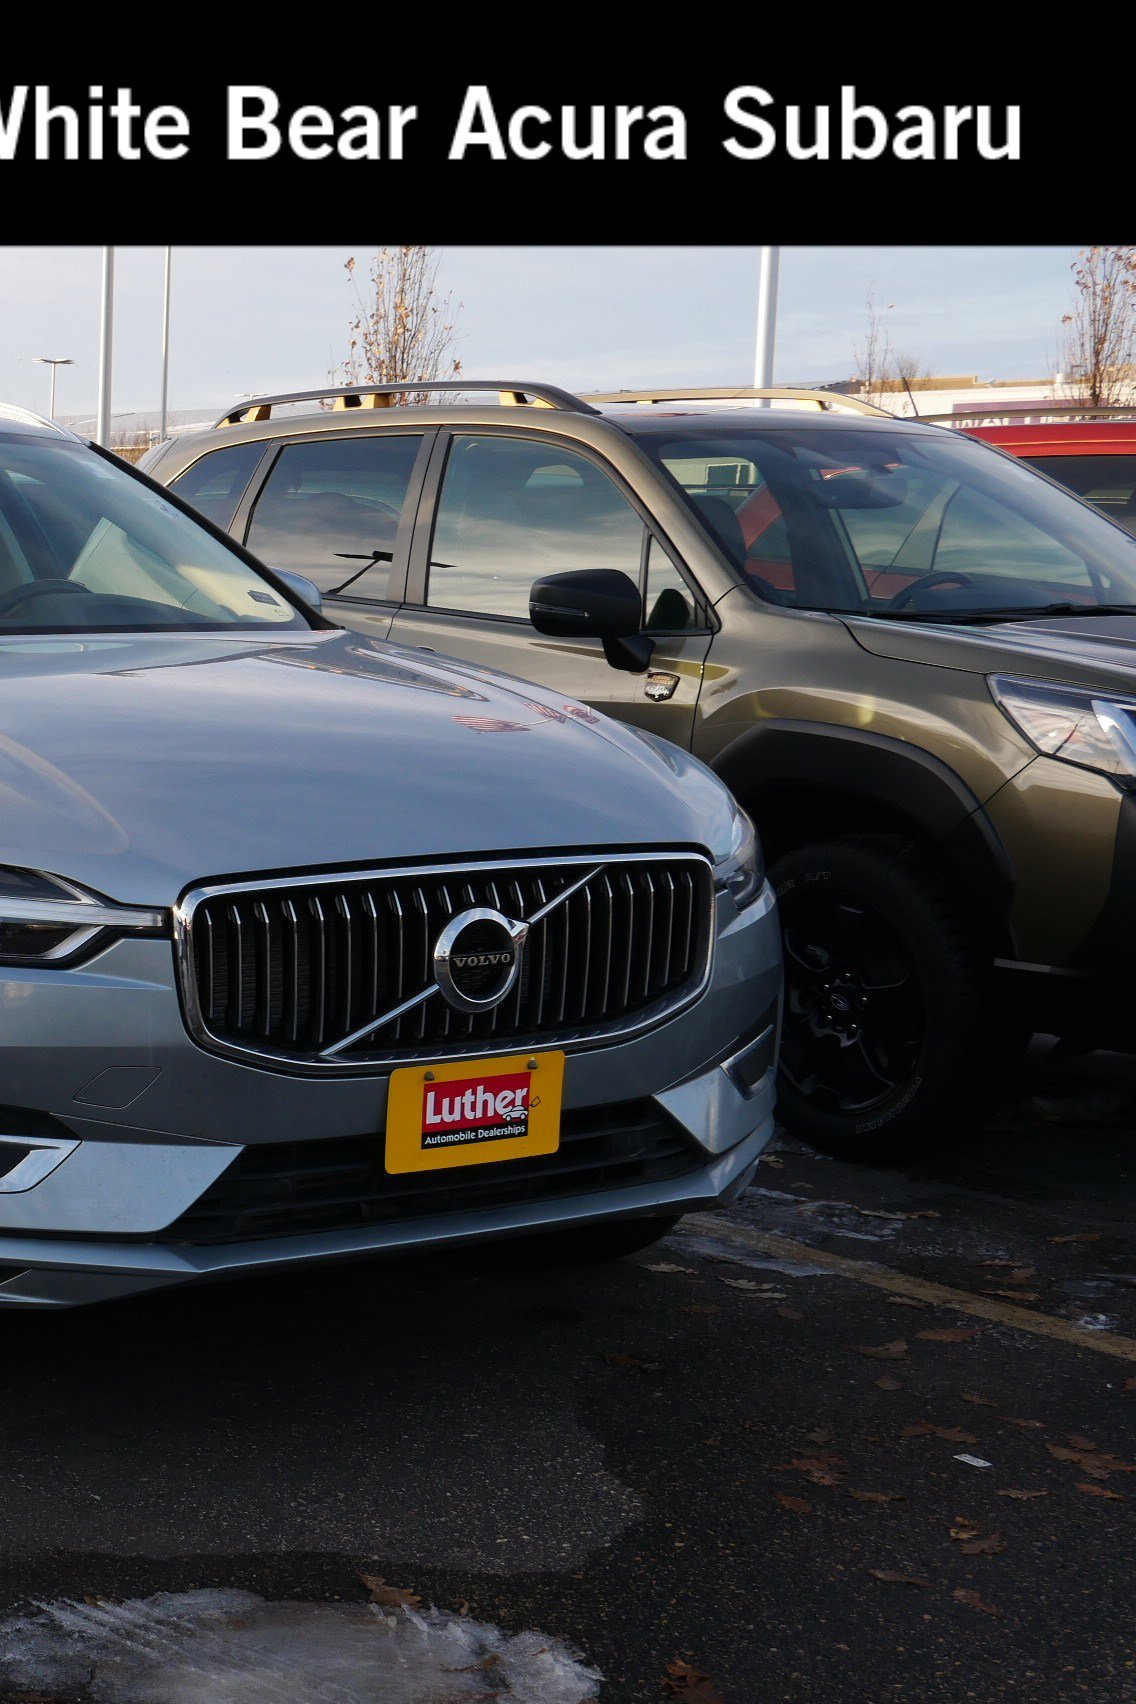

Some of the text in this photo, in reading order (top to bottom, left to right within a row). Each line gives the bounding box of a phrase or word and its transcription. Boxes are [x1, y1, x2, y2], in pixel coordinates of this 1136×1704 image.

[453, 953, 511, 968] VOLVO
[425, 1085, 528, 1125] Luther
[424, 1124, 526, 1145] Automobile Dealerships
